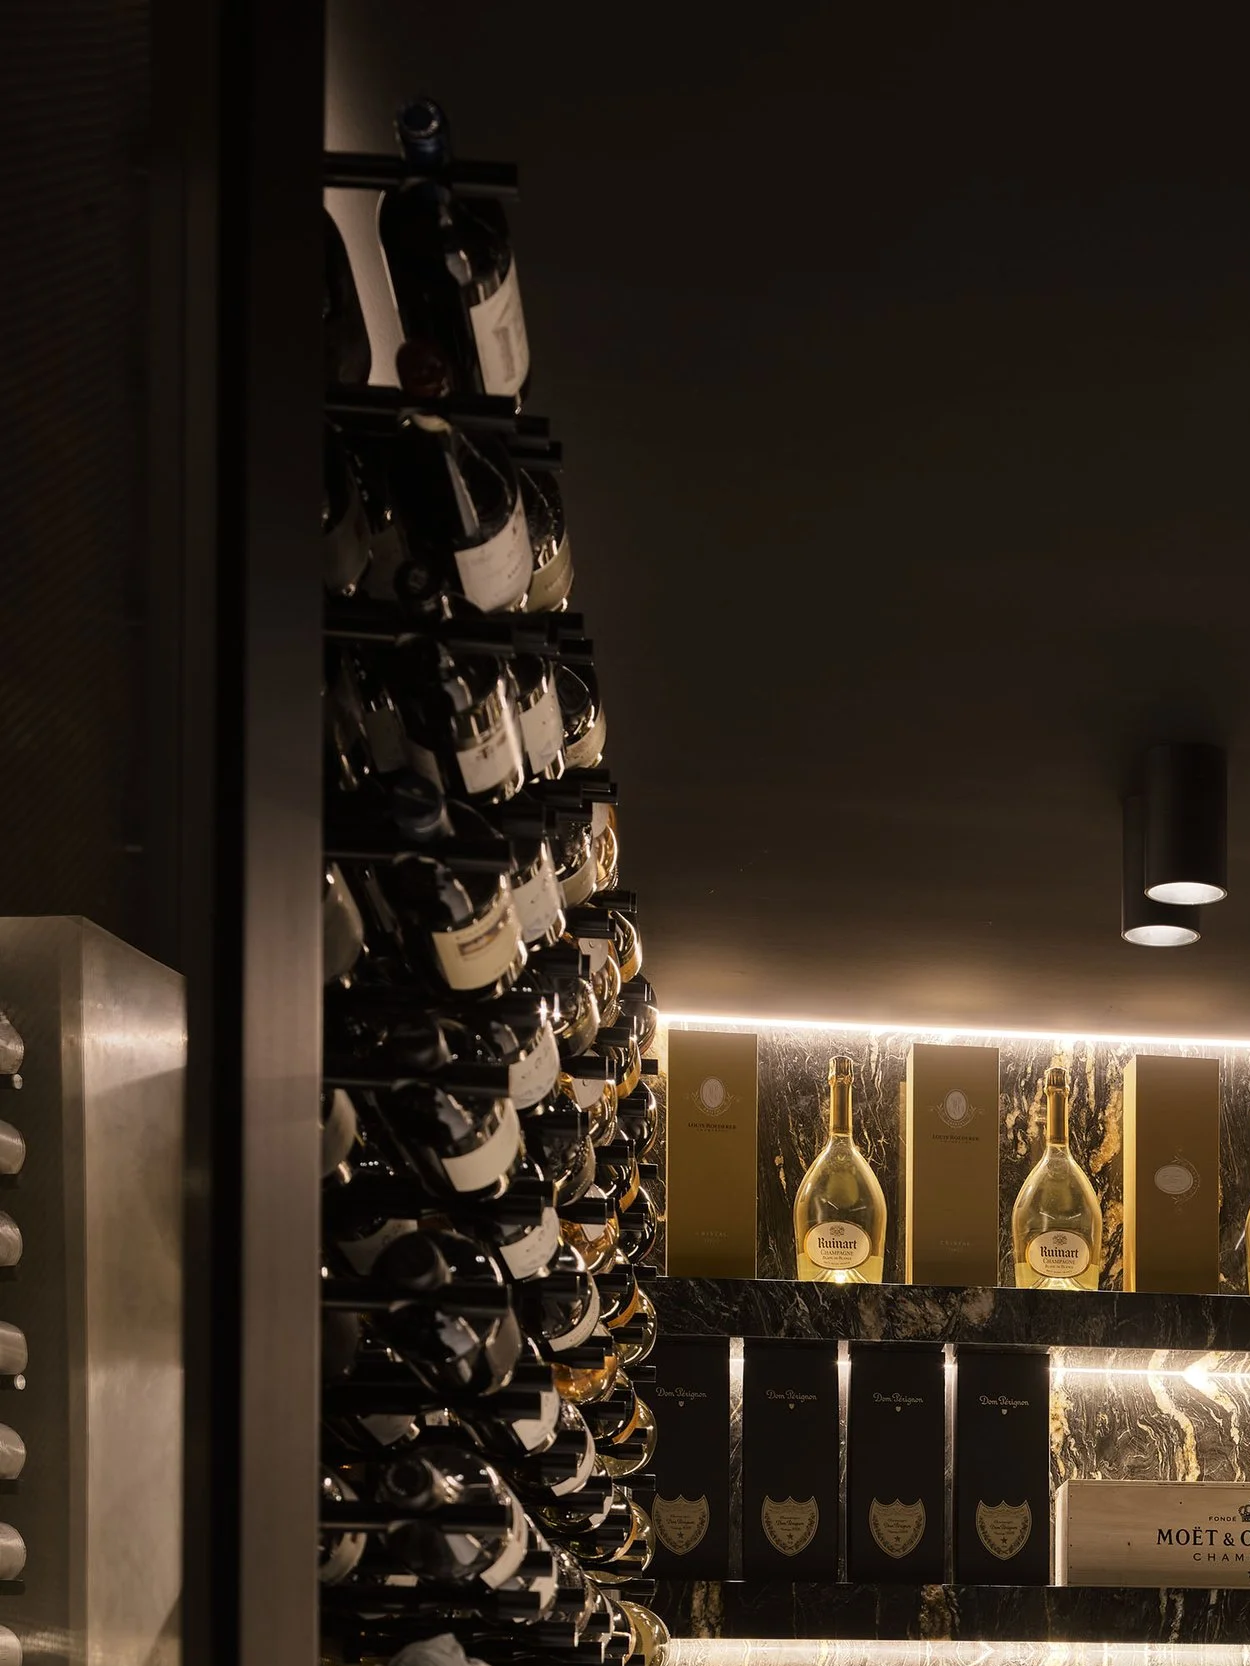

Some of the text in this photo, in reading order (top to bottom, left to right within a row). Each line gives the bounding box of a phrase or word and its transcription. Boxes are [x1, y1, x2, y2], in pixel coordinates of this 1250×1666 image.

[818, 1237, 857, 1249] Ruinart
[1040, 1246, 1079, 1258] Ruinart
[656, 1386, 674, 1397] Dom
[766, 1389, 785, 1400] Dom
[872, 1392, 892, 1402] Dom
[980, 1395, 998, 1405] Dom
[1156, 1526, 1218, 1546] MOËT
[1223, 1533, 1235, 1546] &
